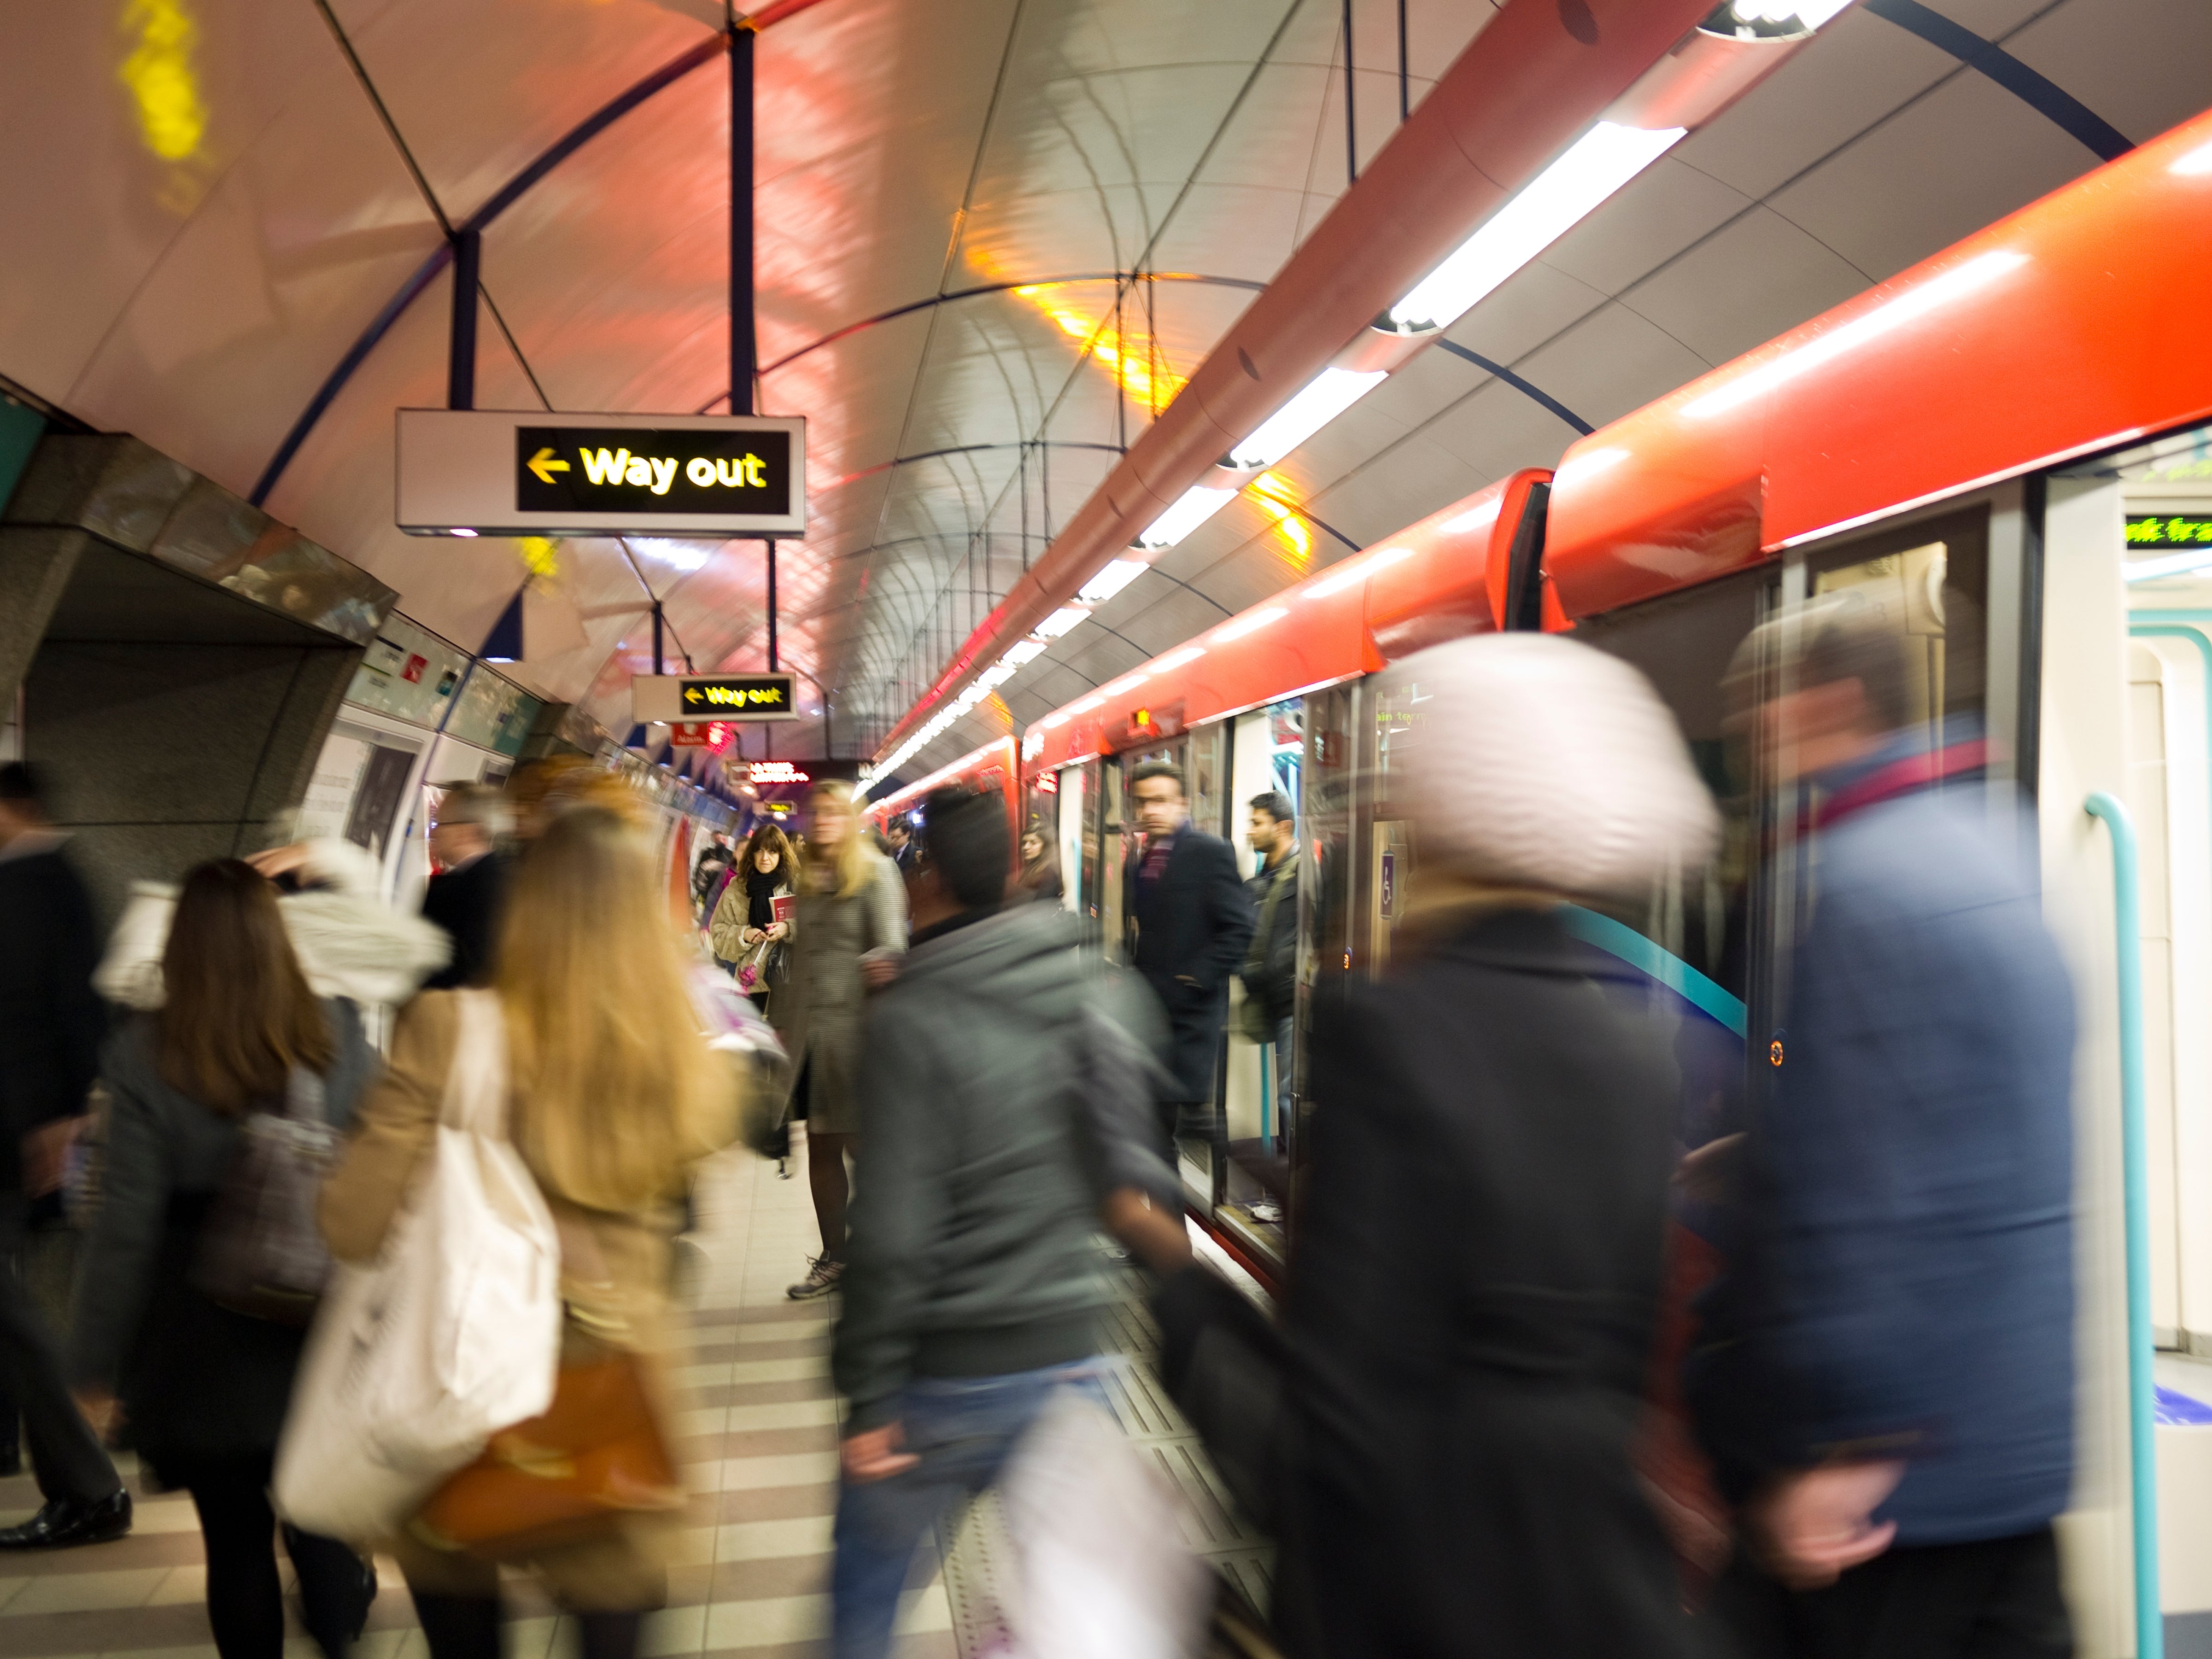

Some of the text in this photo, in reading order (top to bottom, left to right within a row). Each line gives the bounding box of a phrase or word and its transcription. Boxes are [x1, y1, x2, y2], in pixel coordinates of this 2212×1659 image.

[579, 448, 767, 495] Way out
[704, 687, 783, 707] Way out
